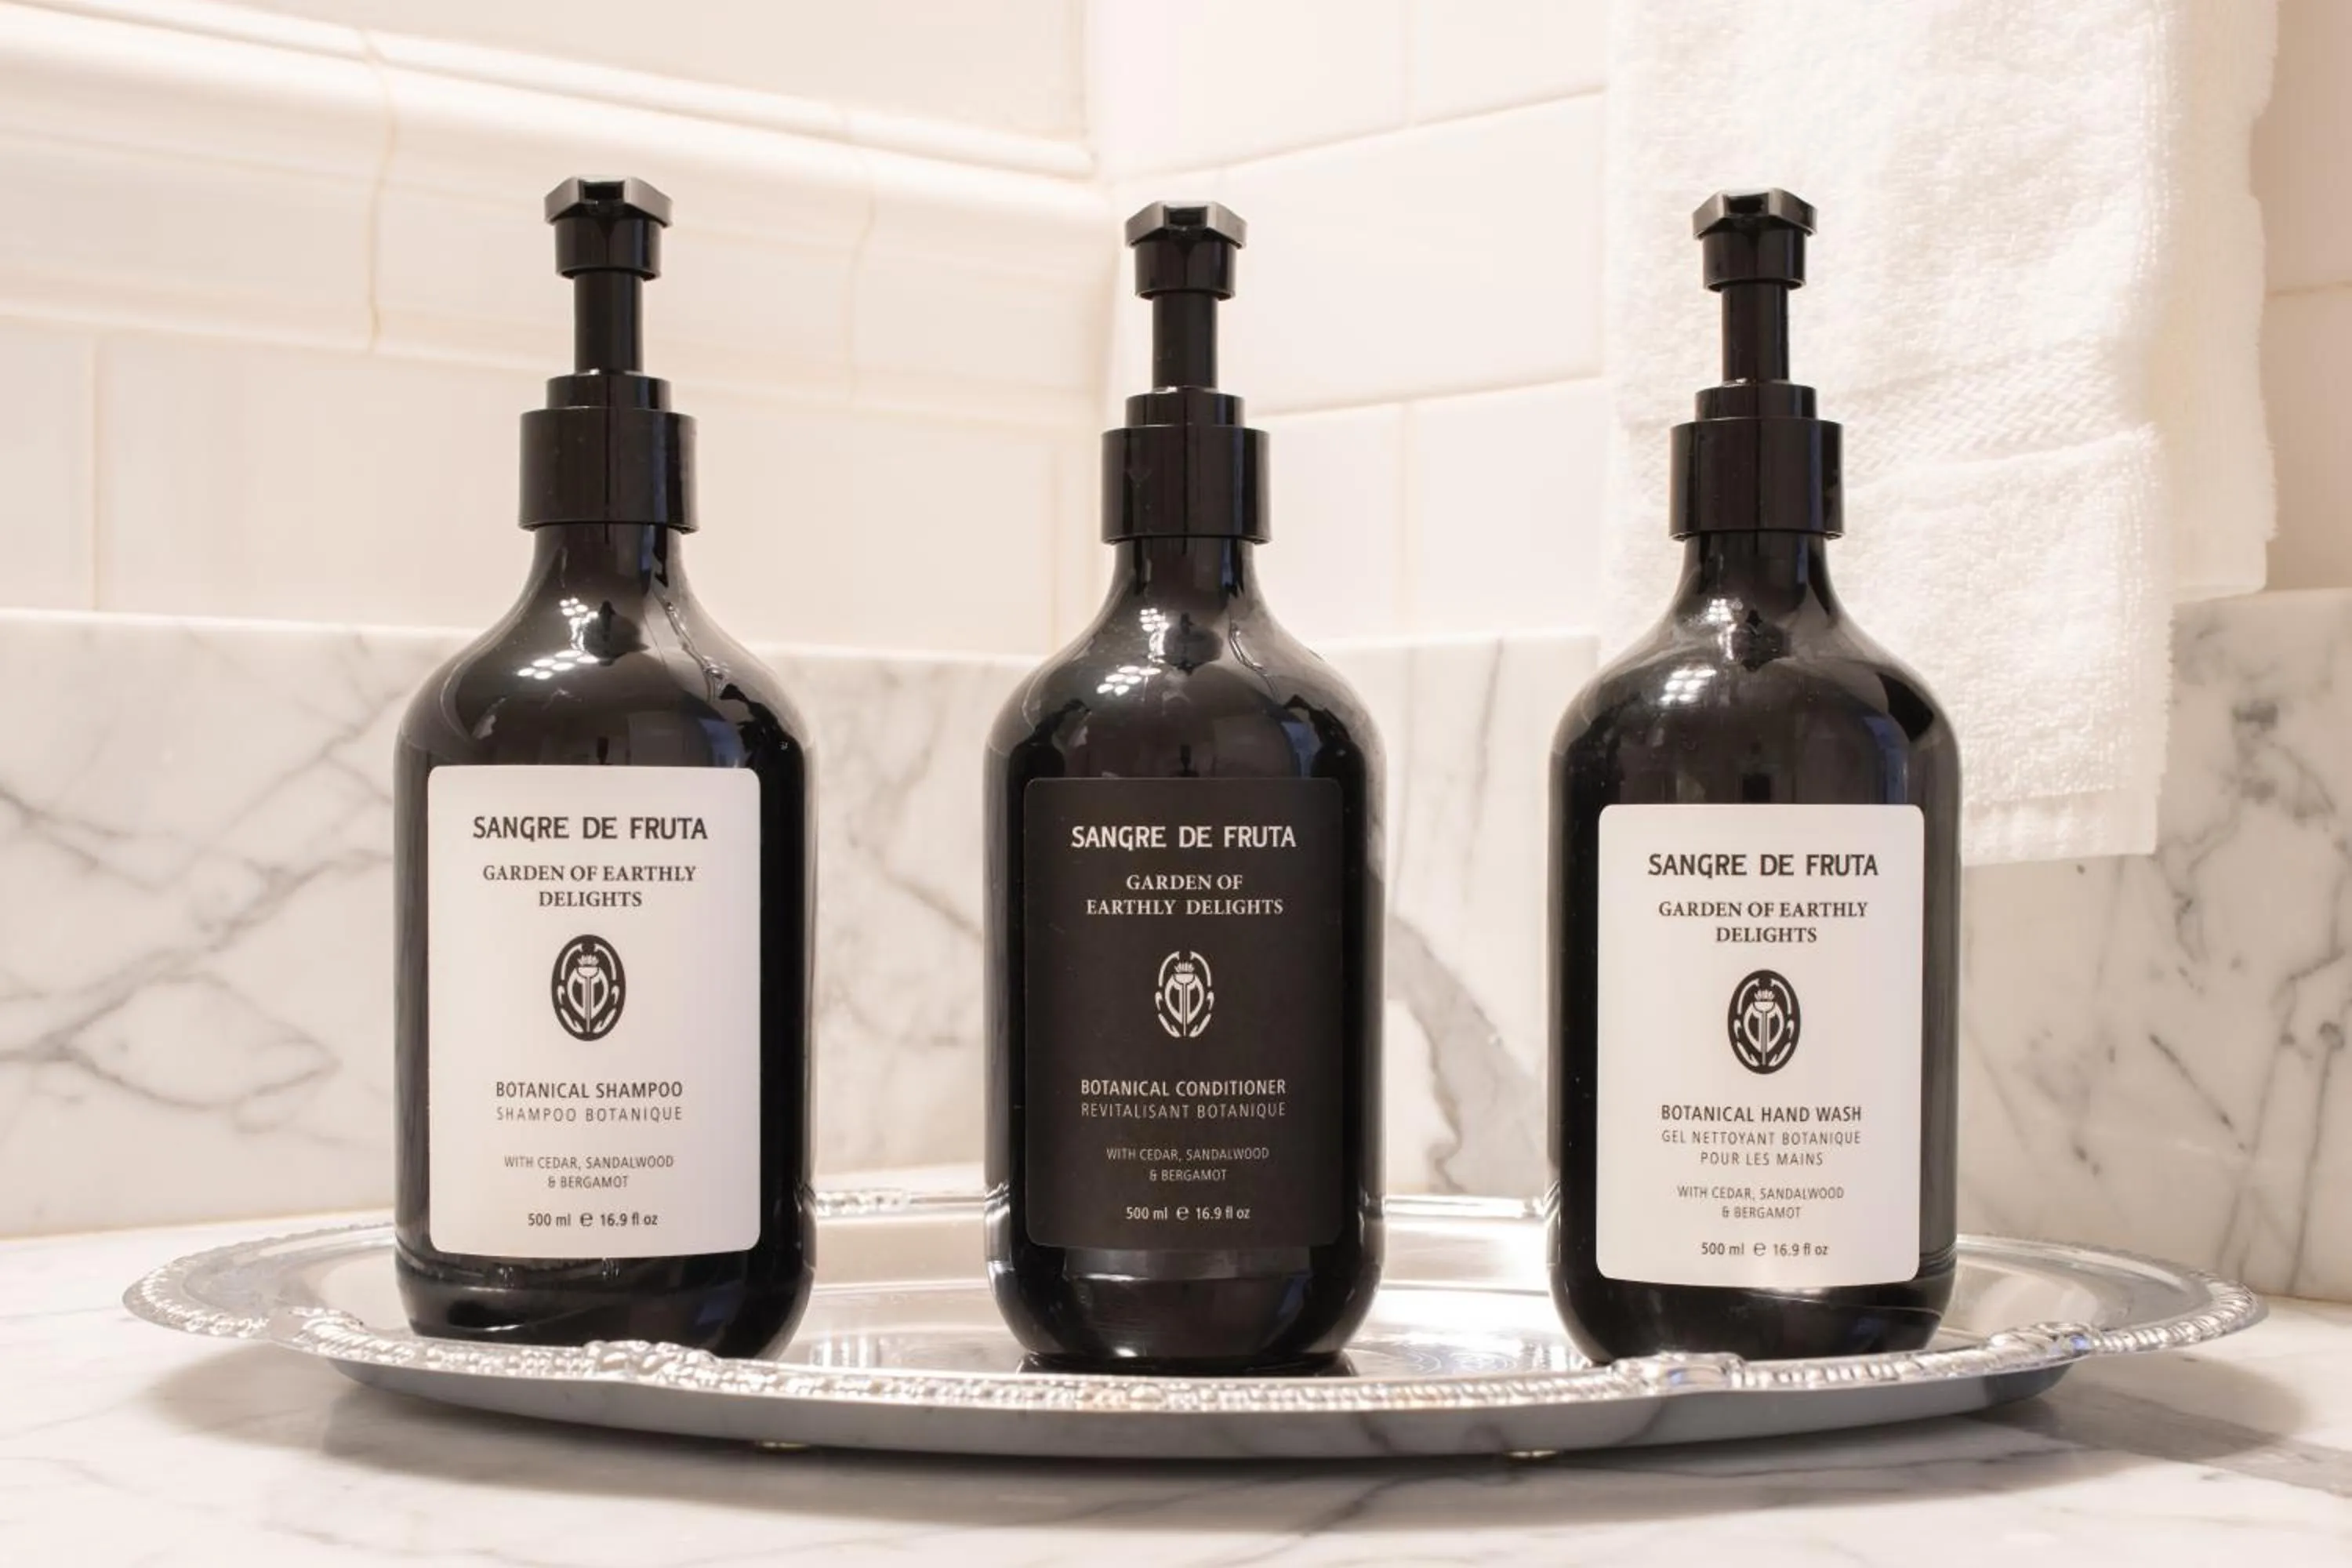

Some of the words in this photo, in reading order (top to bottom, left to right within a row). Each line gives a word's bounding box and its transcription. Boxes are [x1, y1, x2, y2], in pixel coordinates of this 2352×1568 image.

[474, 816, 569, 842] SANGRE
[583, 817, 617, 839] DE
[630, 817, 708, 840] FRUTA
[1072, 826, 1167, 851] SANGRE
[1179, 826, 1212, 848] DE
[1225, 826, 1296, 848] FRUTA
[483, 866, 564, 880] GARDEN
[571, 866, 597, 881] OF
[604, 866, 695, 881] EARTHLY
[1648, 854, 1747, 878] SANGRE
[1760, 855, 1794, 876] DE
[1806, 855, 1878, 876] FRUTA
[1127, 875, 1211, 890] GARDEN
[1217, 875, 1242, 889] OF
[539, 891, 642, 906] DELIGHTS
[1087, 899, 1175, 914] EARTHLY
[1186, 899, 1283, 914] DELIGHTS
[1659, 902, 1742, 916] GARDEN
[1748, 902, 1773, 917] OF
[1780, 902, 1867, 917] EARTHLY
[1717, 927, 1817, 942] DELIGHTS
[497, 1081, 590, 1098] BOTANICAL
[596, 1081, 682, 1098] SHAMPOO
[1082, 1080, 1169, 1096] BOTANICAL
[1176, 1079, 1285, 1096] CONDITIONER
[497, 1107, 576, 1122] SHAMPOO
[586, 1106, 681, 1123] BOTANIQUE
[1082, 1102, 1189, 1119] REVITALISANT
[1197, 1102, 1284, 1119] BOTANIQUE
[1662, 1105, 1754, 1122] BOTANICAL
[1762, 1107, 1809, 1122] HAND
[1816, 1106, 1861, 1122] WASH
[1662, 1130, 1686, 1143] GEL
[1693, 1131, 1774, 1145] NETTOYANT
[1782, 1131, 1860, 1146] BOTANIQUE
[1107, 1148, 1135, 1160] WITH
[1140, 1149, 1181, 1162] CEDAR,
[1186, 1148, 1269, 1160] SANDALWOOD
[1700, 1152, 1740, 1165] POUR
[1746, 1152, 1769, 1166] LES
[1777, 1152, 1822, 1166] MAINS
[505, 1156, 533, 1167] WITH
[538, 1156, 581, 1171] CEDAR,
[586, 1156, 673, 1169] SANDALWOOD
[548, 1176, 556, 1188] &
[561, 1176, 628, 1189] BERGAMOT
[1149, 1169, 1157, 1181] &
[1162, 1169, 1226, 1181] BERGAMOT
[1677, 1185, 1708, 1198] WITH
[1711, 1186, 1755, 1201] CEDAR,
[1760, 1186, 1844, 1200] SANDALWOOD
[528, 1213, 552, 1226] 500
[556, 1214, 571, 1226] ml
[601, 1213, 627, 1226] 16.9
[632, 1212, 639, 1225] fl
[644, 1215, 658, 1225] oz
[1127, 1207, 1149, 1219] 500
[1153, 1207, 1167, 1220] ml
[1196, 1207, 1221, 1220] 16.9
[1225, 1206, 1232, 1219] fl
[1236, 1209, 1250, 1219] oz
[1722, 1206, 1730, 1218] &
[1734, 1207, 1801, 1218] BERGAMOT
[1702, 1242, 1725, 1254] 500
[1729, 1243, 1744, 1254] ml
[1774, 1243, 1799, 1256] 16.9
[1802, 1243, 1811, 1255] fl
[1815, 1246, 1829, 1255] oz
